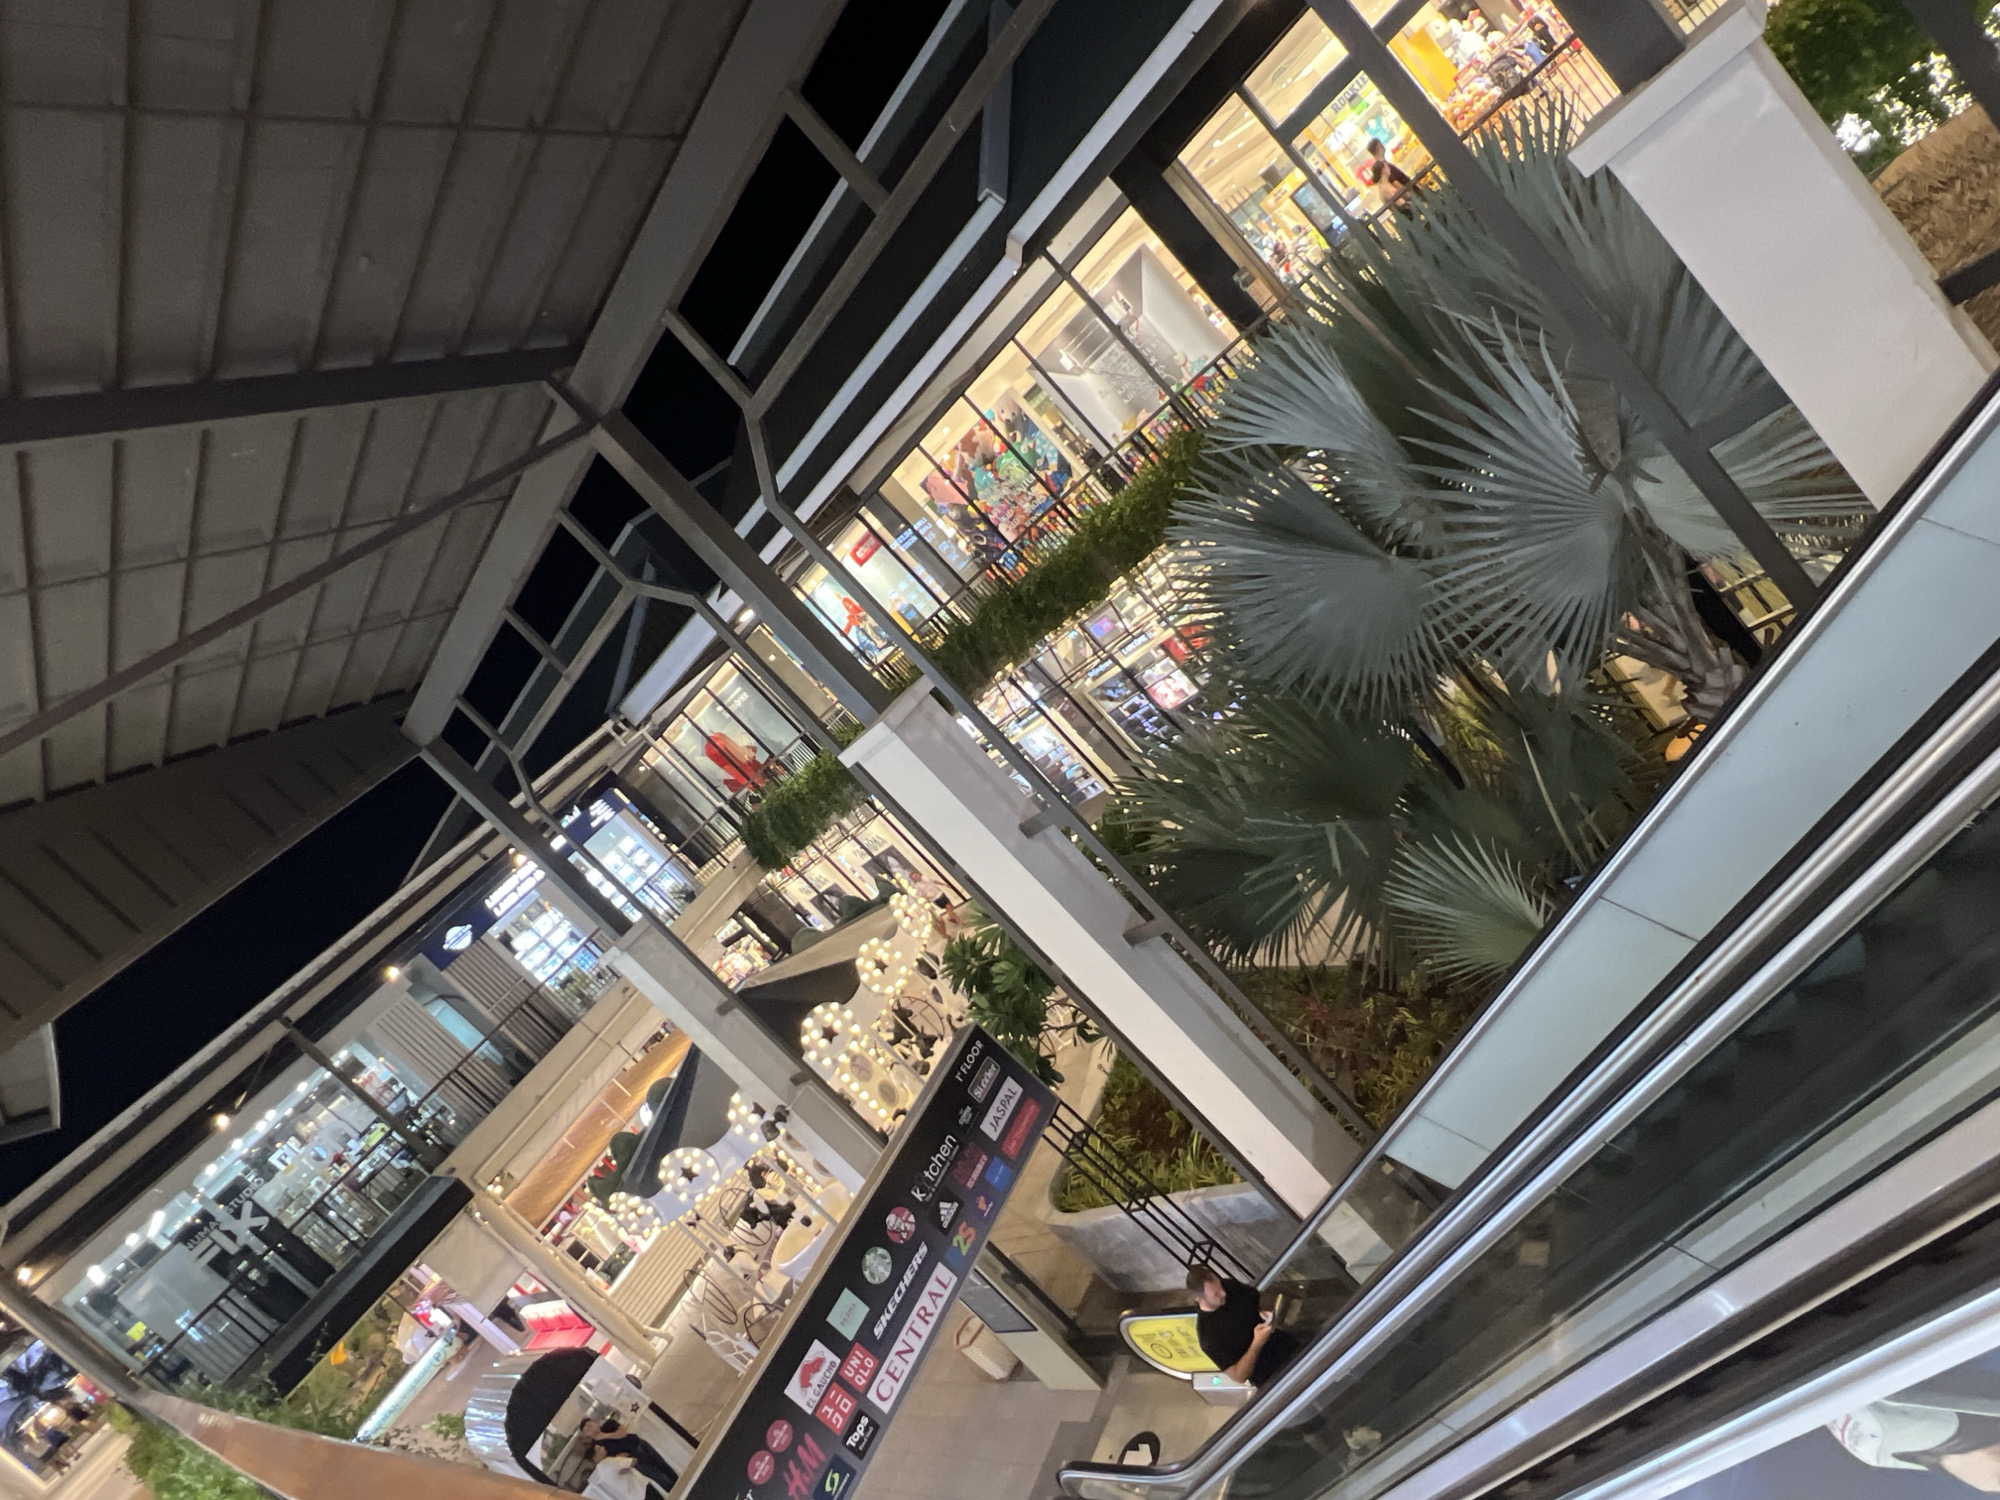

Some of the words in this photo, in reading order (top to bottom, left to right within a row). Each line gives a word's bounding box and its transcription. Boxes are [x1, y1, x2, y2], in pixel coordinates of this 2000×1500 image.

[1330, 73, 1368, 112] ROOKIE
[959, 1039, 984, 1074] FLOOR
[973, 1062, 998, 1098] Sizzler
[990, 1089, 1017, 1132] JASPAL
[909, 1135, 957, 1201] ktchen
[225, 1176, 265, 1214] STUDIO
[873, 1240, 929, 1340] SKECHERS
[875, 1275, 952, 1401] CENTRAL
[843, 1349, 863, 1378] UNI
[853, 1355, 875, 1386] QLO
[806, 1394, 817, 1409] EL
[812, 1359, 837, 1397] GAUCHO
[845, 1415, 870, 1446] Tops
